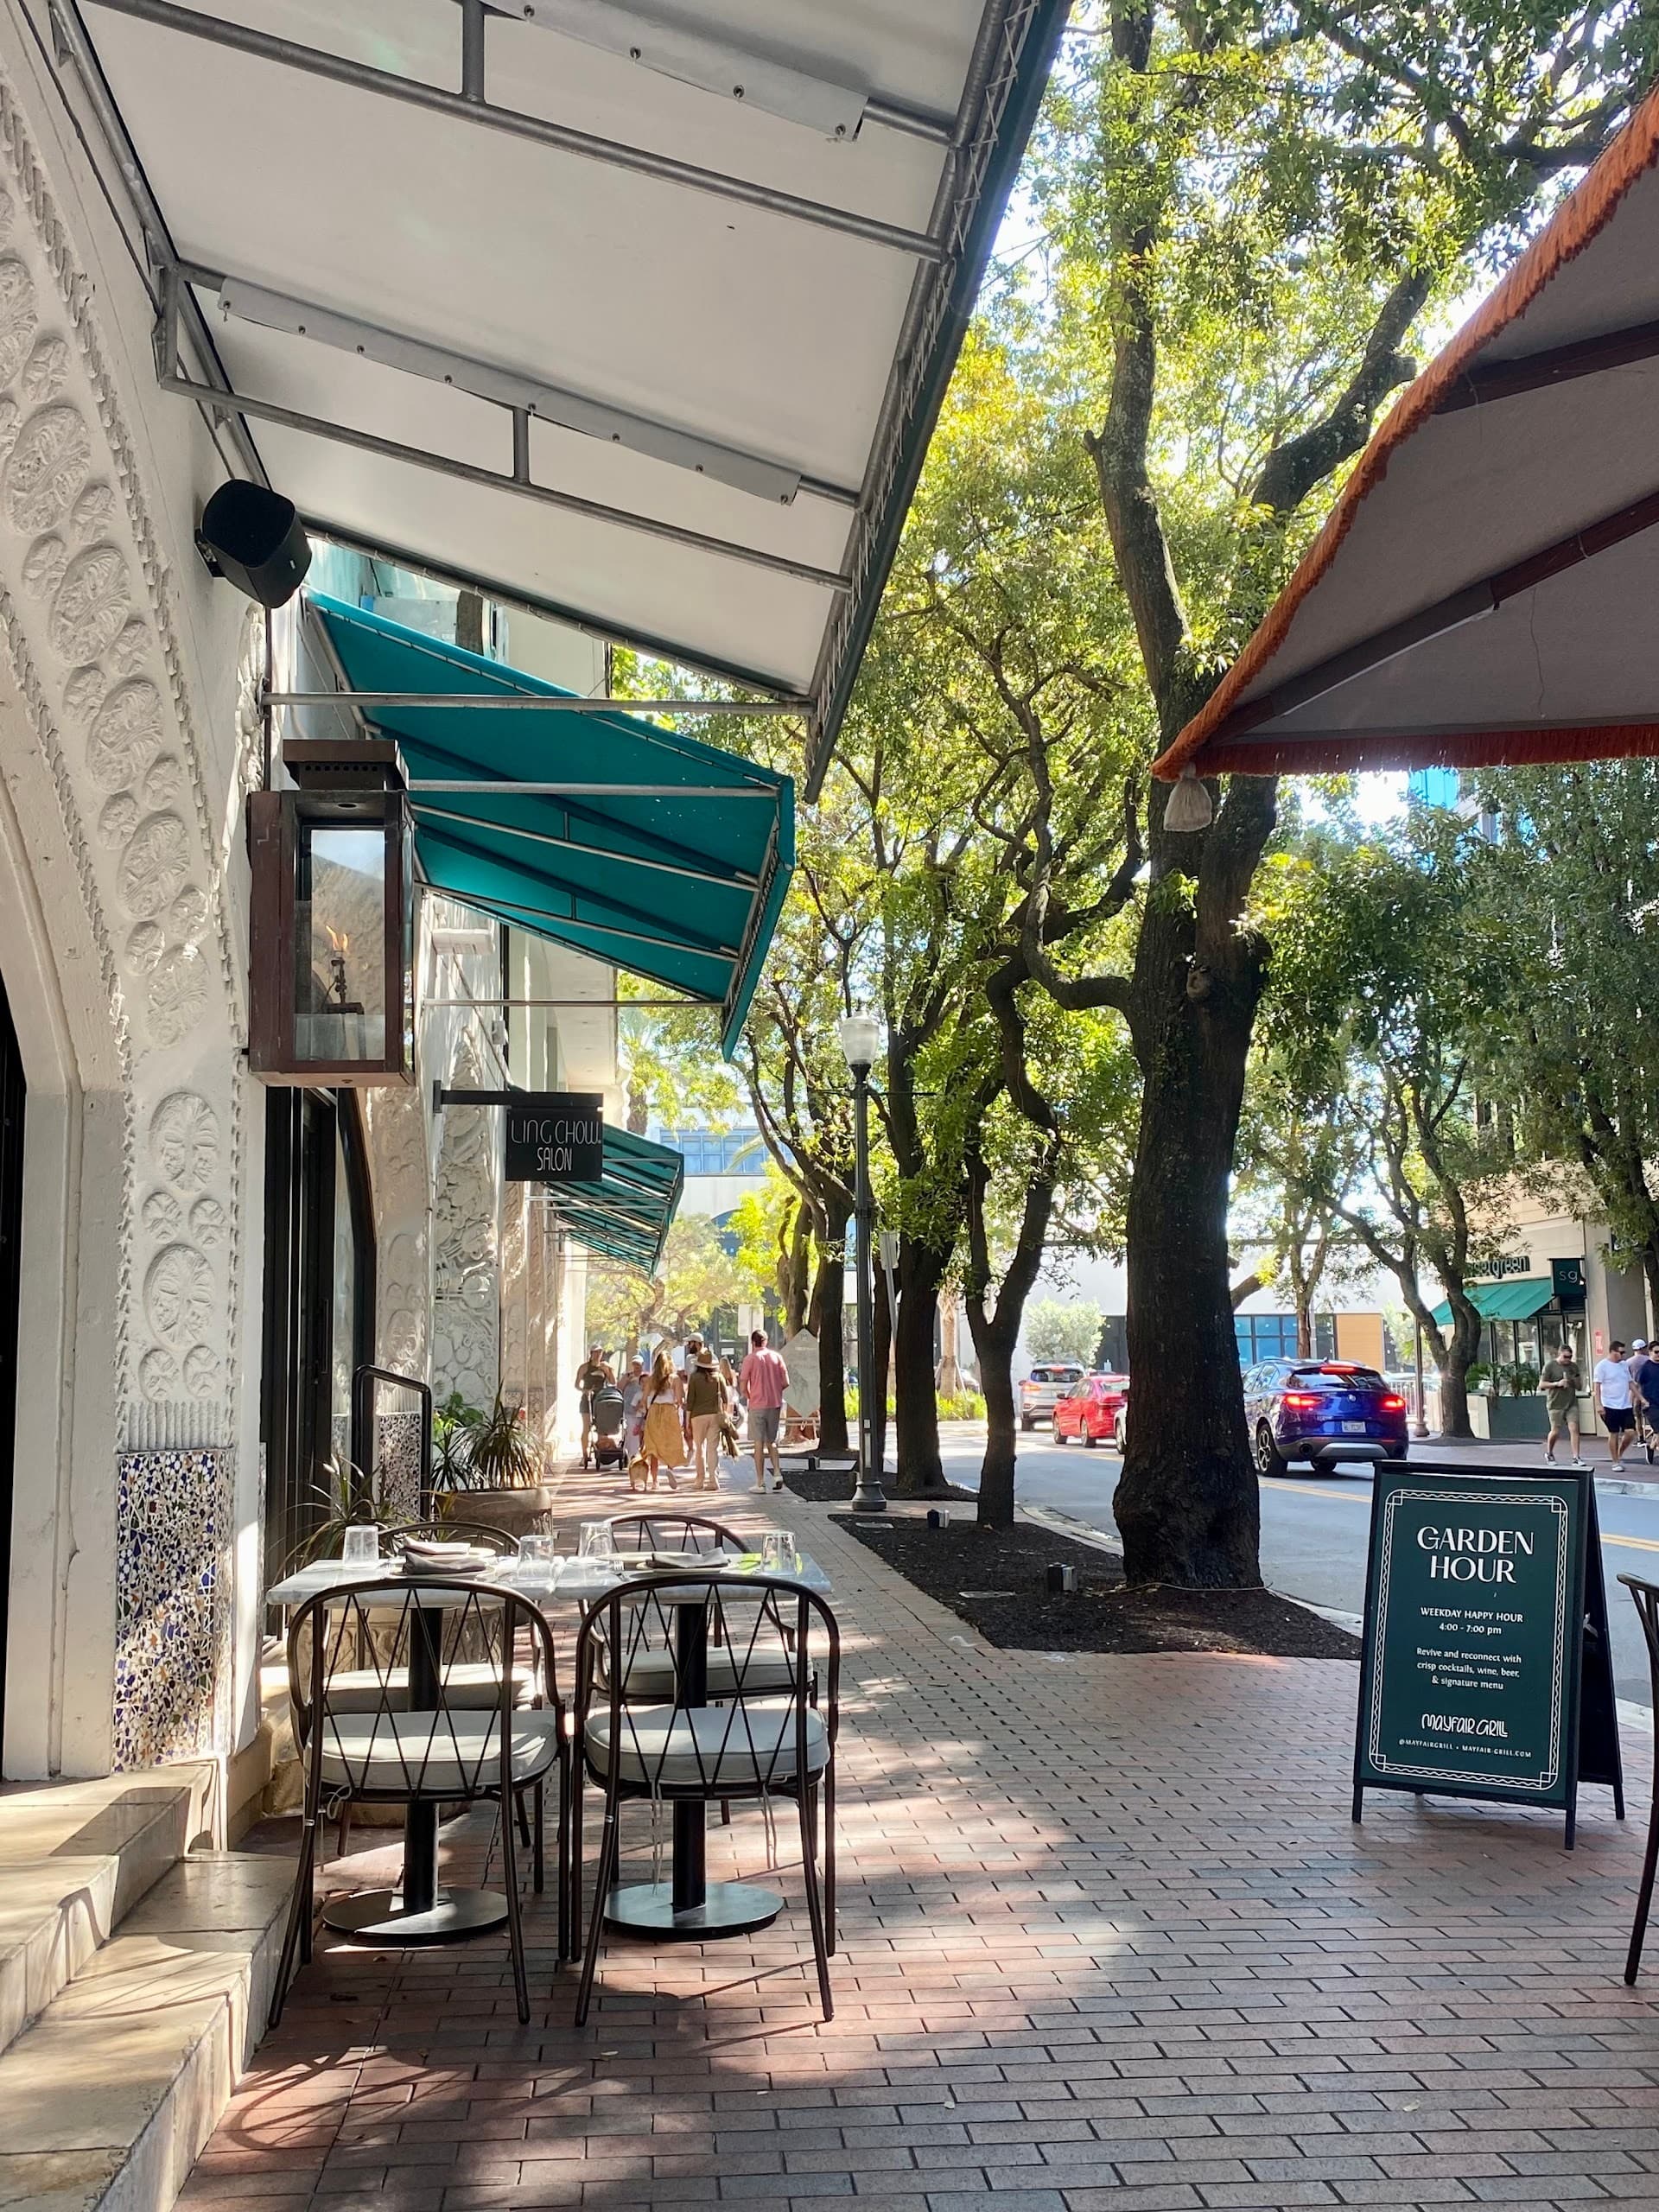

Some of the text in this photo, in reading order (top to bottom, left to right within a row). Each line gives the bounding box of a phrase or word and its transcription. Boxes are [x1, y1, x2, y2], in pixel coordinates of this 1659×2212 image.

[511, 1119, 552, 1144] LING
[537, 1147, 573, 1171] SALON
[1559, 1270, 1578, 1283] sg
[1416, 1526, 1534, 1555] GARDEN
[1430, 1555, 1517, 1583] HOUR
[1420, 1606, 1523, 1623] WEEKDAY HAPPY HOUR
[1439, 1622, 1459, 1631] 4:00
[1466, 1624, 1484, 1633] 7:00
[1487, 1626, 1502, 1636] pm
[1416, 1647, 1522, 1663] Revive and reconnect with
[1416, 1662, 1521, 1678] crisp cocktails, wine, beer,
[1431, 1675, 1504, 1690] & signature menu
